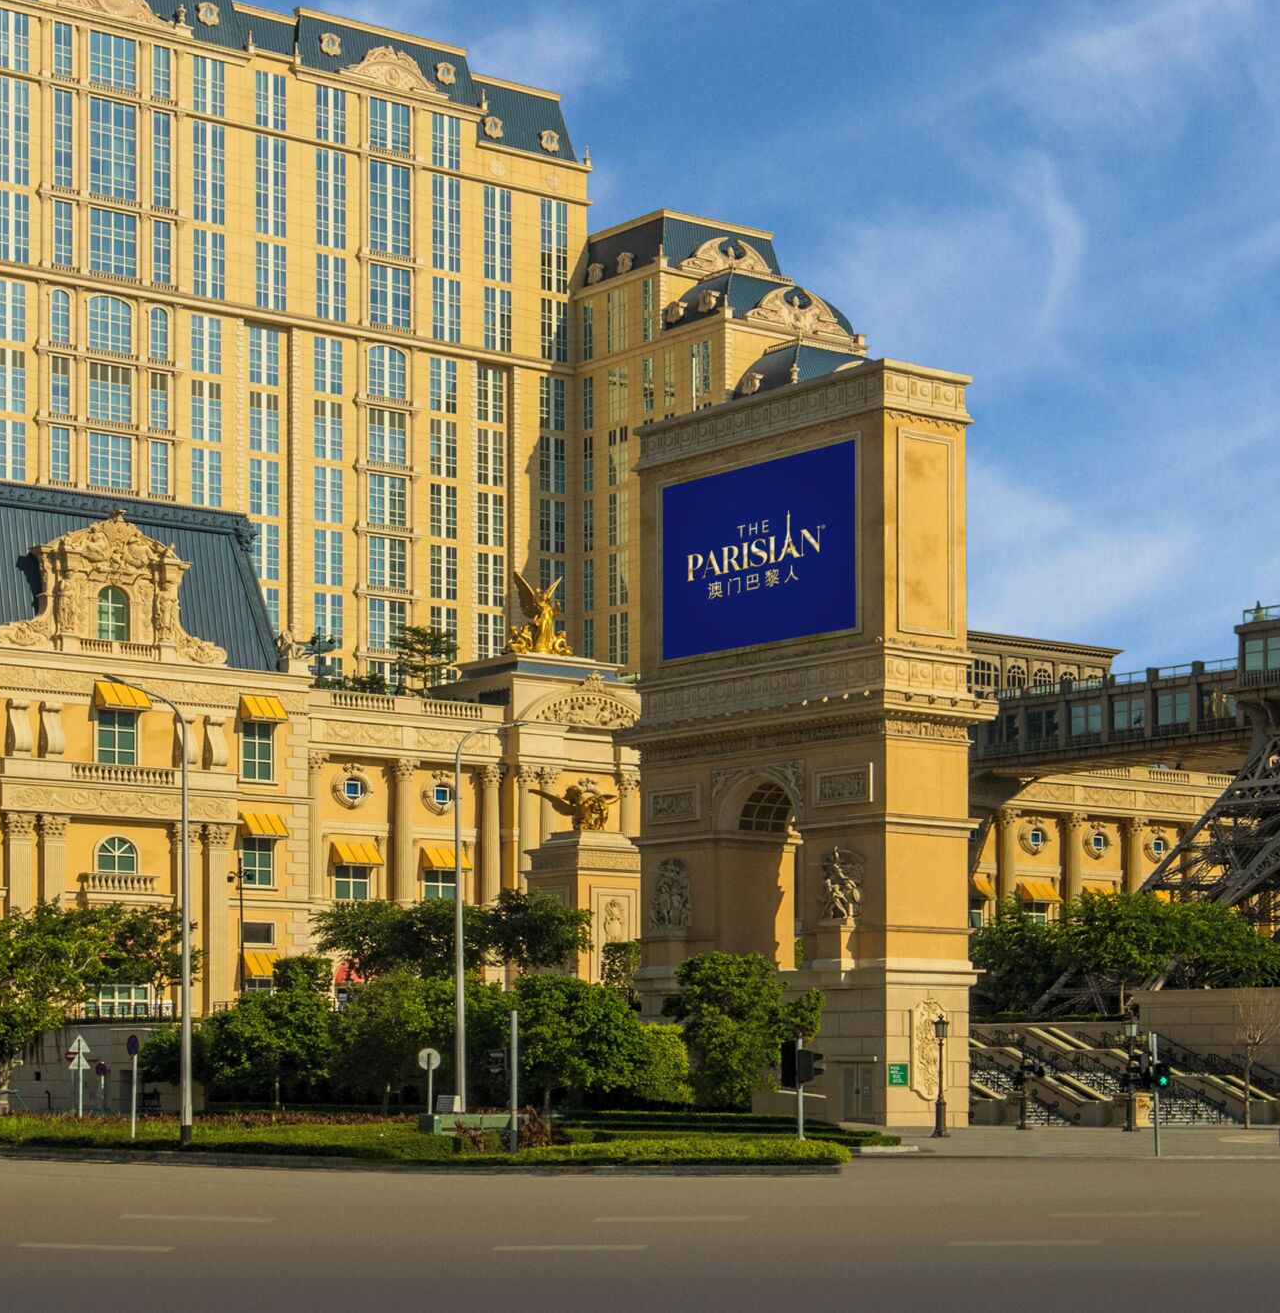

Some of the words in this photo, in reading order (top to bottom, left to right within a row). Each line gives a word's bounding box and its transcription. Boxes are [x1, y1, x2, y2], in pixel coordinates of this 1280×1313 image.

[686, 509, 821, 582] PARISIAN
[737, 519, 770, 538] THE
[707, 564, 799, 600] 澳门巴黎人
